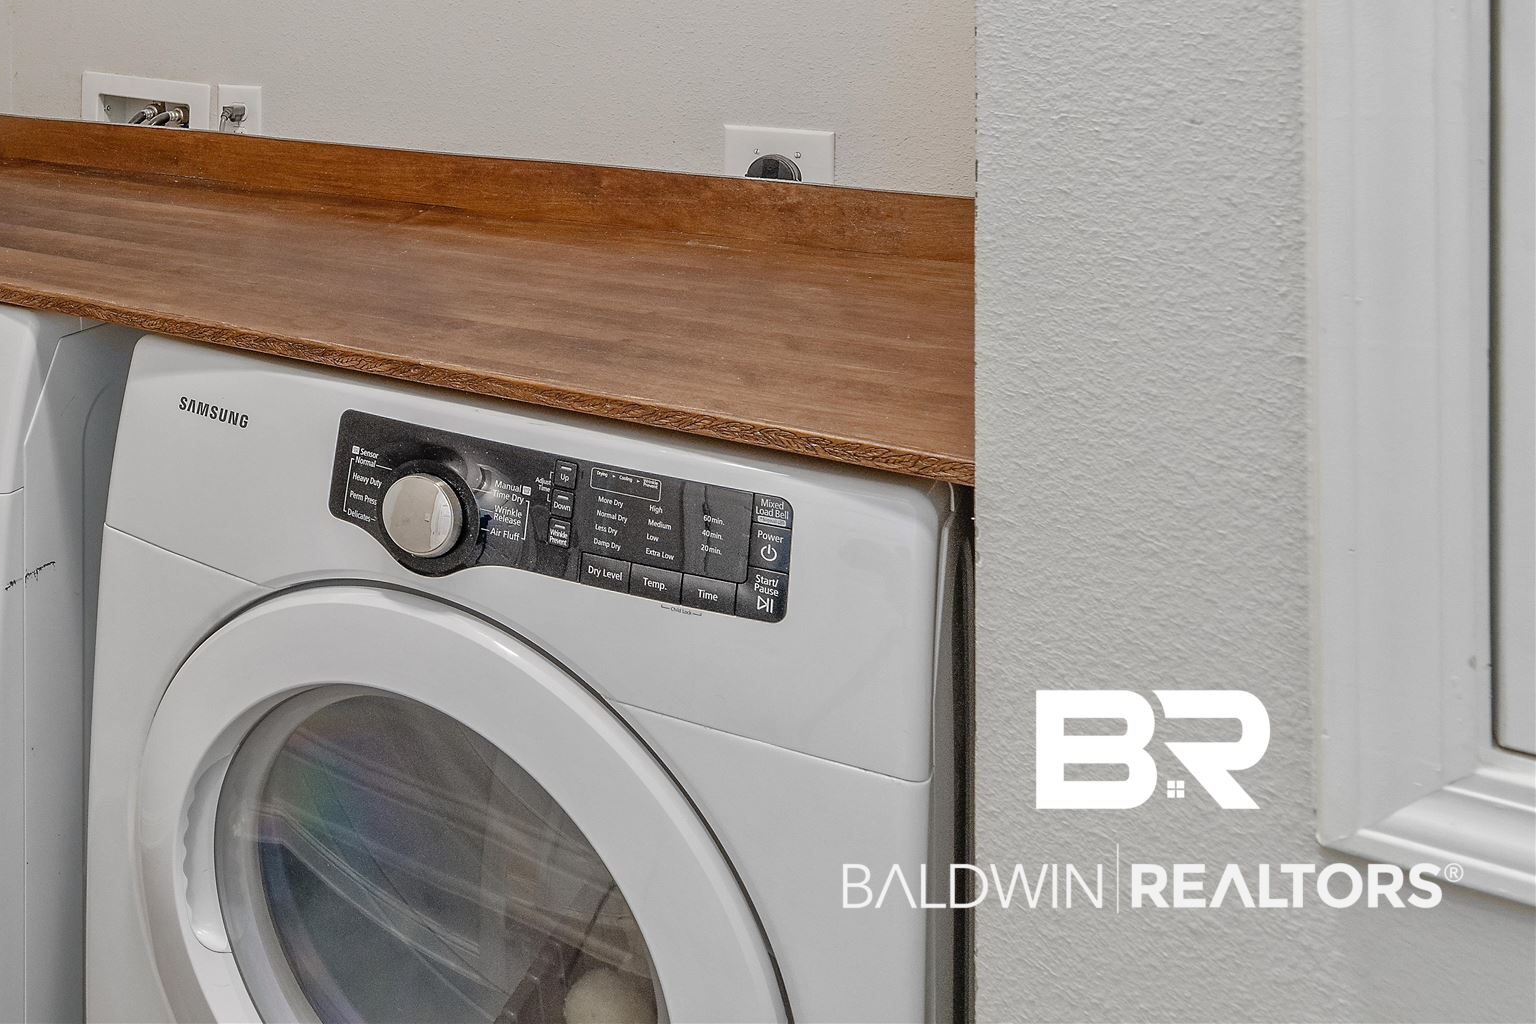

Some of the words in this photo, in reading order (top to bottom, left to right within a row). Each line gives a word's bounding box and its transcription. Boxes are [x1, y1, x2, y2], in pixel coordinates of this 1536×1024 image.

[178, 396, 249, 429] SAMSUNG
[360, 448, 379, 459] Sensor
[355, 456, 376, 468] Normal
[353, 472, 369, 485] Heavy
[370, 477, 382, 488] Duty
[535, 477, 551, 486] Adjust
[560, 473, 570, 482] Up
[494, 480, 522, 493] Manual
[350, 490, 364, 501] Perm
[364, 495, 377, 505] Press
[493, 490, 510, 500] Time
[511, 494, 524, 505] Dry
[598, 496, 612, 505] More
[614, 499, 623, 509] Dry
[761, 498, 784, 510] Mixed
[494, 505, 522, 518] Wrinkle
[553, 502, 571, 511] Down
[649, 505, 663, 515] High
[756, 506, 774, 516] Load
[774, 510, 789, 520] Bell
[347, 508, 370, 522] Delicates
[493, 513, 521, 526] Release
[597, 510, 616, 520] Normal
[618, 514, 628, 523] Dry
[595, 524, 607, 533] Less
[608, 527, 618, 536] Dry
[648, 519, 672, 530] Medium
[490, 528, 501, 536] Air
[503, 531, 520, 541] Fluff
[550, 528, 568, 539] Wrinkle
[646, 533, 659, 542] Low
[757, 530, 784, 543] Power
[593, 538, 610, 548] Damp
[611, 542, 621, 552] Dry
[646, 548, 660, 557] Extra
[662, 552, 675, 560] Low
[588, 565, 601, 578] Dry
[602, 568, 623, 581] Level
[643, 577, 667, 591] Temp.
[755, 574, 779, 587] Start/
[698, 589, 718, 601] Time
[754, 582, 779, 596] Pause
